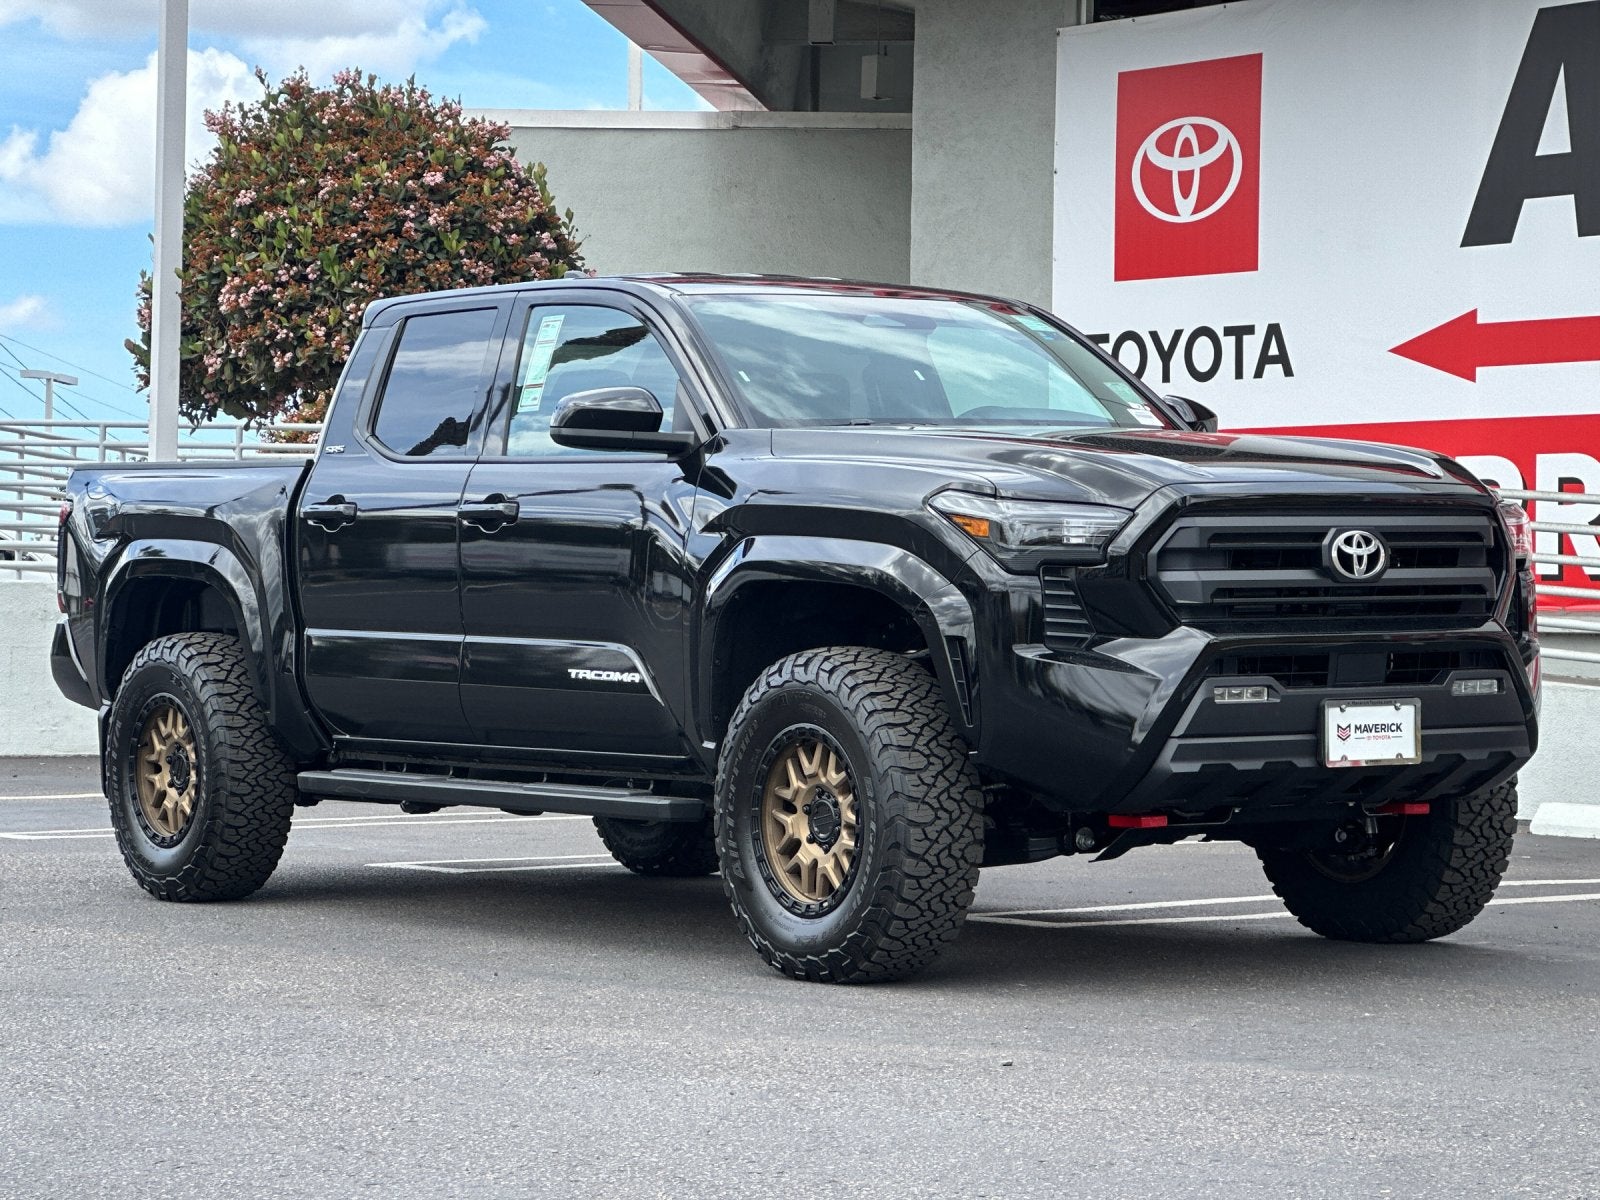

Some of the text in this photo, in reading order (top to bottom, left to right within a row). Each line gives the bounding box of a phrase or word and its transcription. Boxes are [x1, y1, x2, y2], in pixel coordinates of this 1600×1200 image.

[1460, 1, 1600, 247] A
[567, 668, 641, 683] TACOMA
[1354, 723, 1403, 734] MAVERICK
